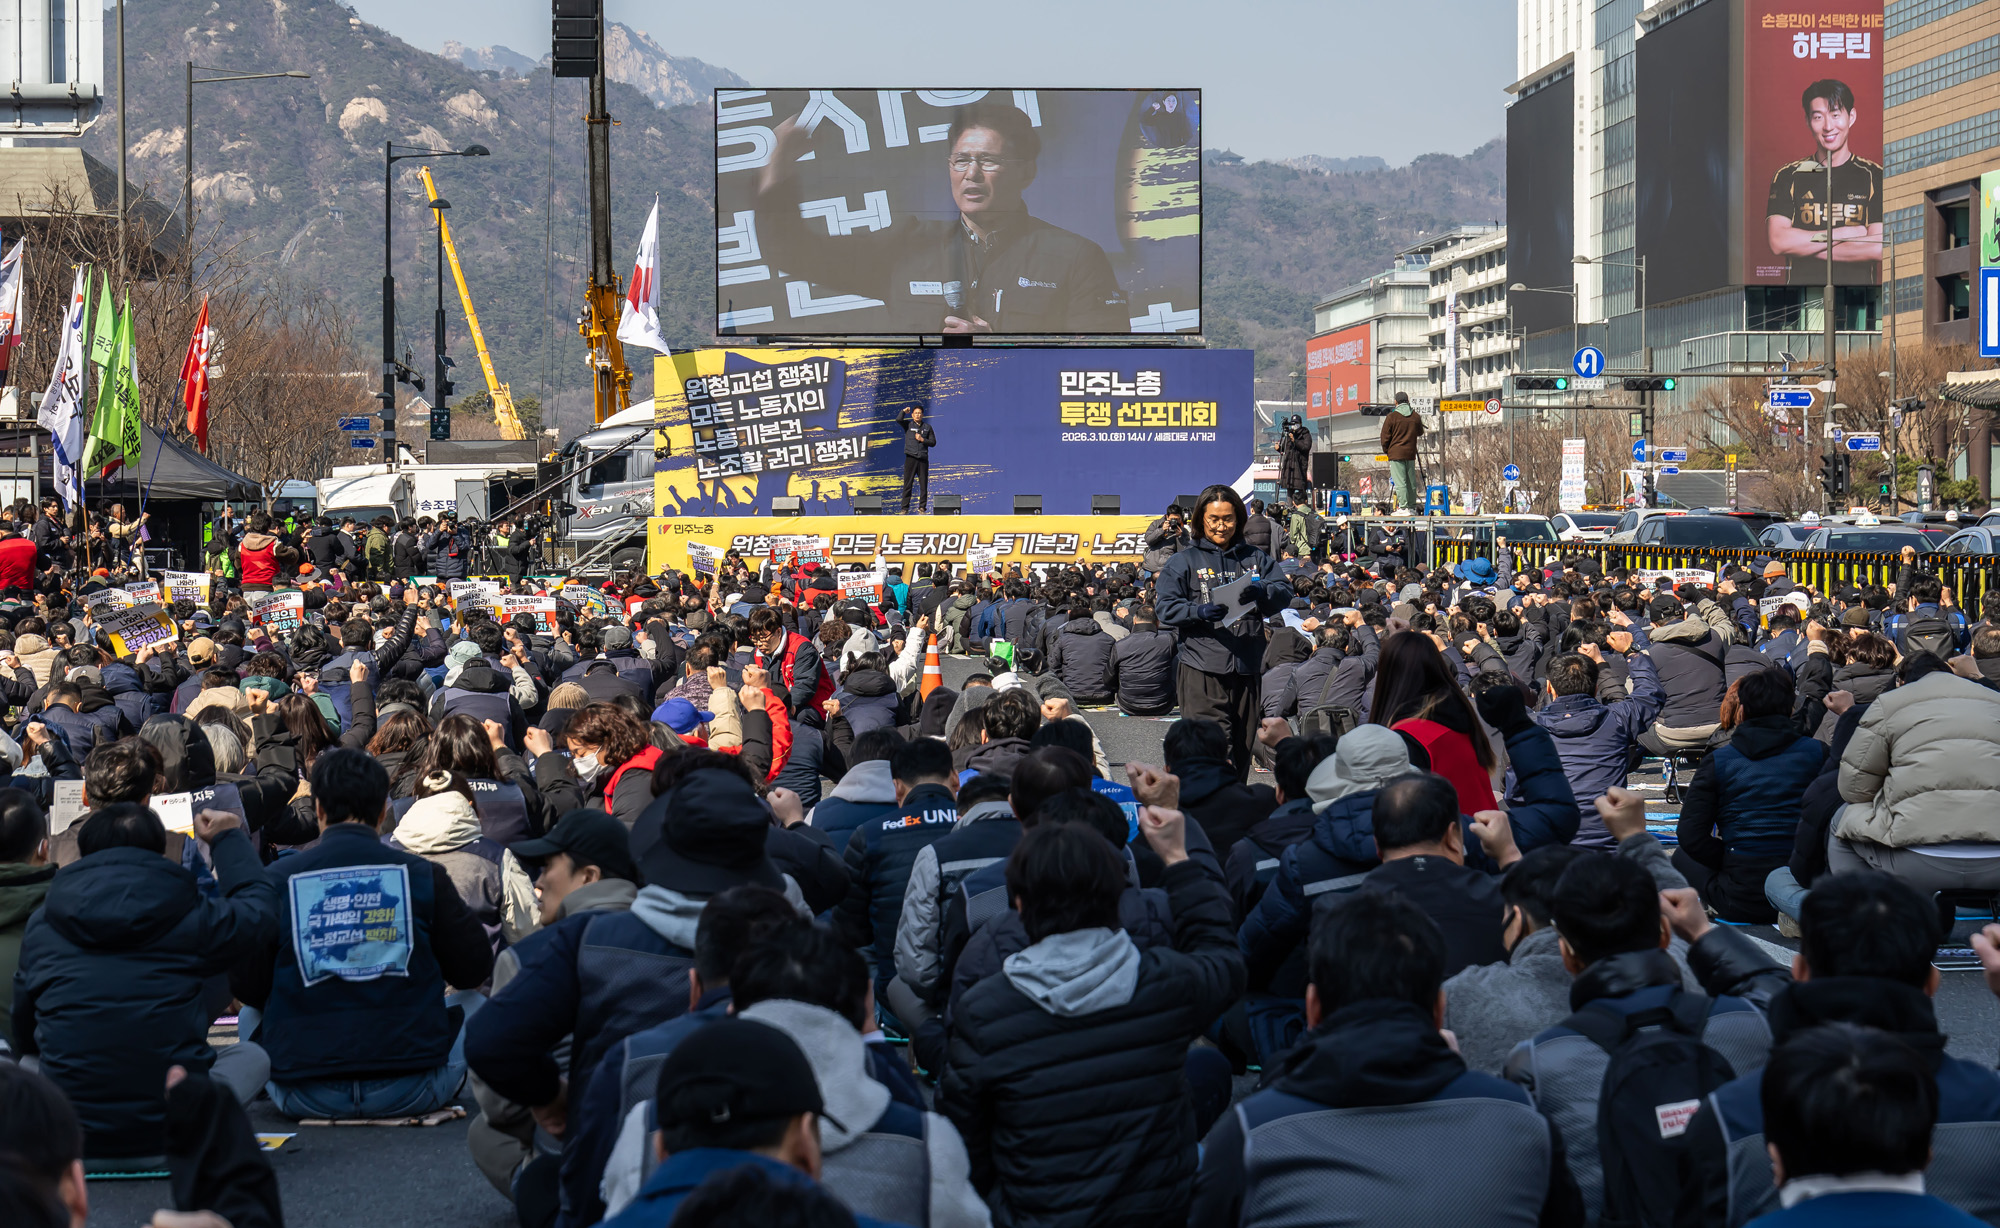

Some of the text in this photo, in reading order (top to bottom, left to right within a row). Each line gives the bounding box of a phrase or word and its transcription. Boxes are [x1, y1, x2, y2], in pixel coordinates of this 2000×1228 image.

[1762, 13, 1815, 28] 손흥민이
[1818, 13, 1859, 28] 선택한
[1793, 32, 1871, 59] 하루틴
[1800, 202, 1864, 226] 하루틴
[686, 361, 830, 401] 원청교섭 쟁취!
[1060, 370, 1161, 396] 민주노총
[689, 389, 826, 428] 모든 노동자의
[1060, 401, 1218, 427] 투쟁 선포대회
[1488, 403, 1499, 411] 50
[694, 418, 803, 453] 노동기본권
[1062, 432, 1125, 442] 2026.3.10.(화)
[1127, 432, 1146, 442] 14시
[1154, 432, 1188, 442] 세종대로
[1190, 432, 1216, 442] 사거리
[697, 436, 867, 480] 노조할 권리 쟁취!
[576, 504, 613, 520] XEN
[674, 524, 714, 535] 민주노총
[832, 533, 878, 556] 모든
[881, 533, 966, 556] 노동자의
[971, 533, 1080, 556] 노동기본권
[190, 789, 216, 804] 지부
[882, 815, 921, 831] FedEx
[323, 892, 382, 913] 생명·안전
[309, 908, 395, 928] 국가책임 강화!
[310, 928, 364, 949] 노정교섭
